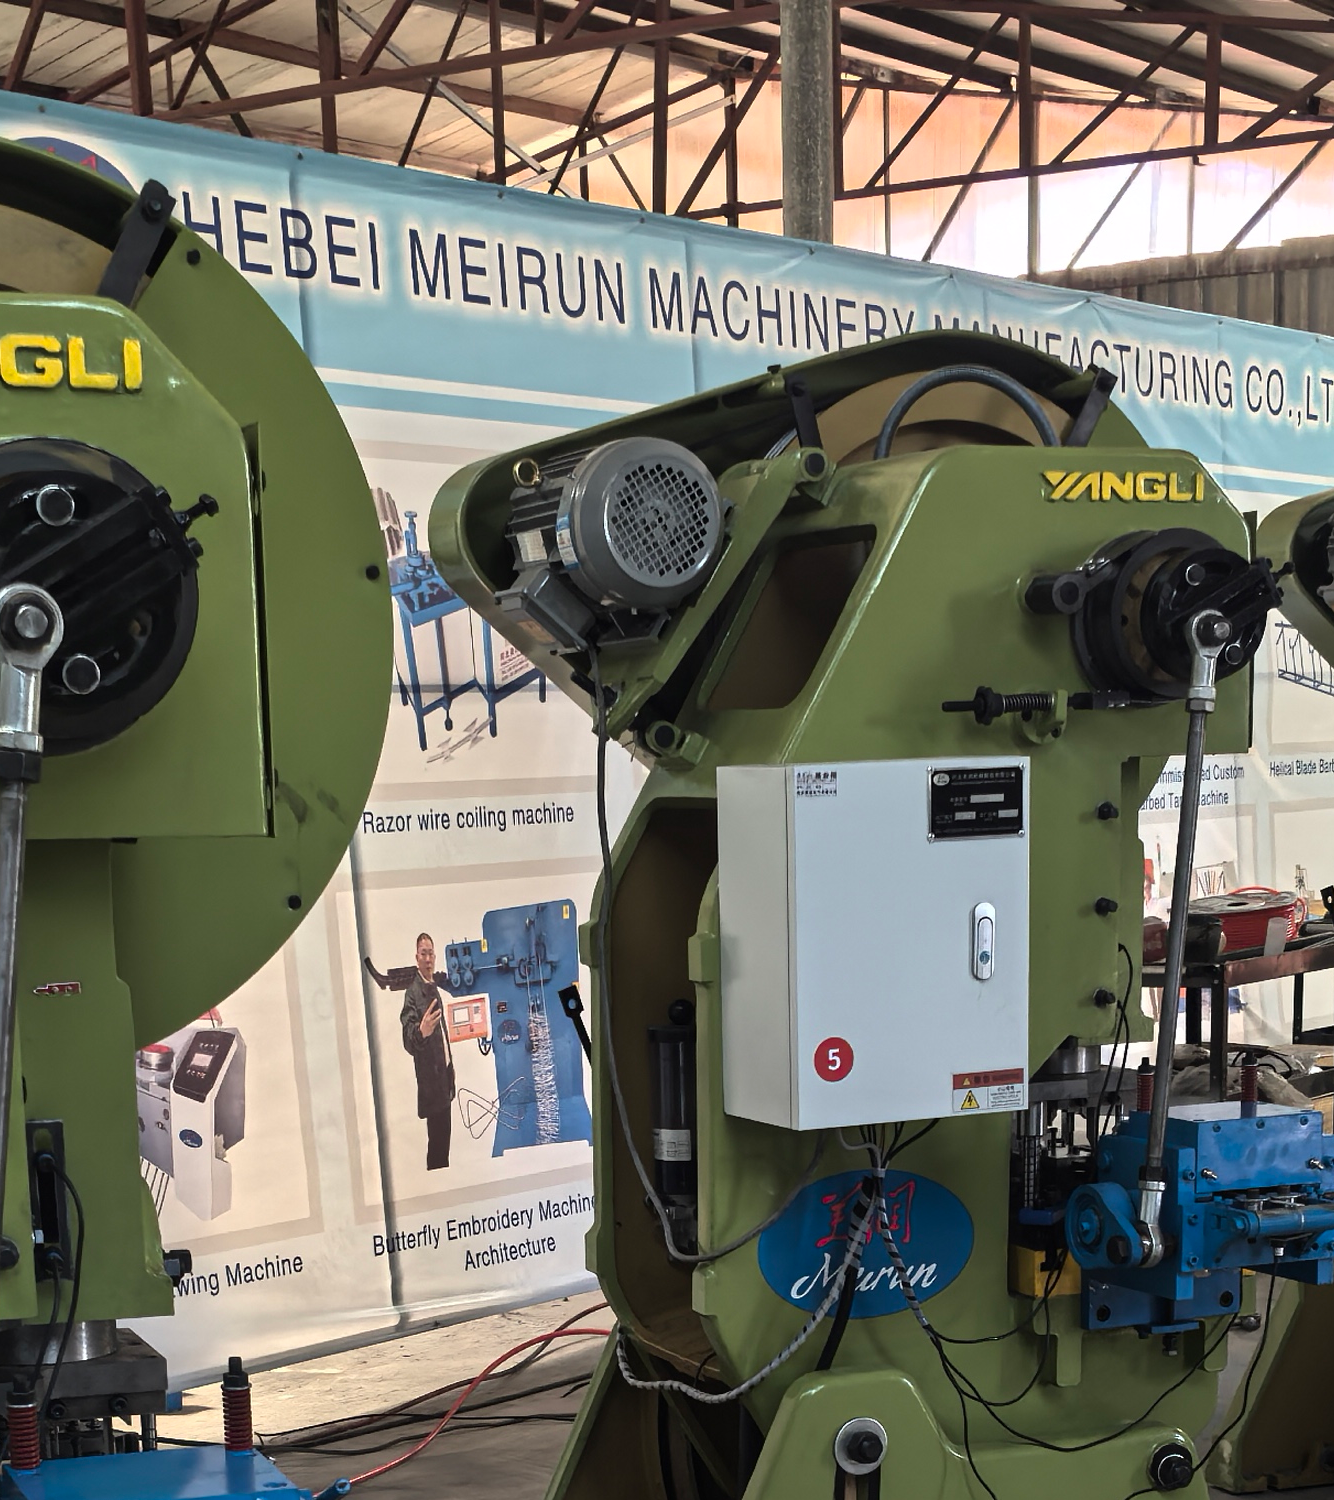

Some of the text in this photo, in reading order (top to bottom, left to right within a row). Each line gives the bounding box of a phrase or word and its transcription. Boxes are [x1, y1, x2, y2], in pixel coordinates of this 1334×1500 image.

[182, 190, 381, 290] HEBEI
[409, 229, 626, 325] MEIRUN
[1041, 469, 1205, 503] YANGLI
[1212, 764, 1245, 780] Custom
[362, 801, 575, 834] Razor wire coiling machine
[827, 1048, 841, 1071] 5
[373, 1224, 441, 1257] Butterfly
[446, 1206, 534, 1241] Embroidery
[465, 1235, 557, 1271] Architecture
[225, 1254, 304, 1287] Machine
